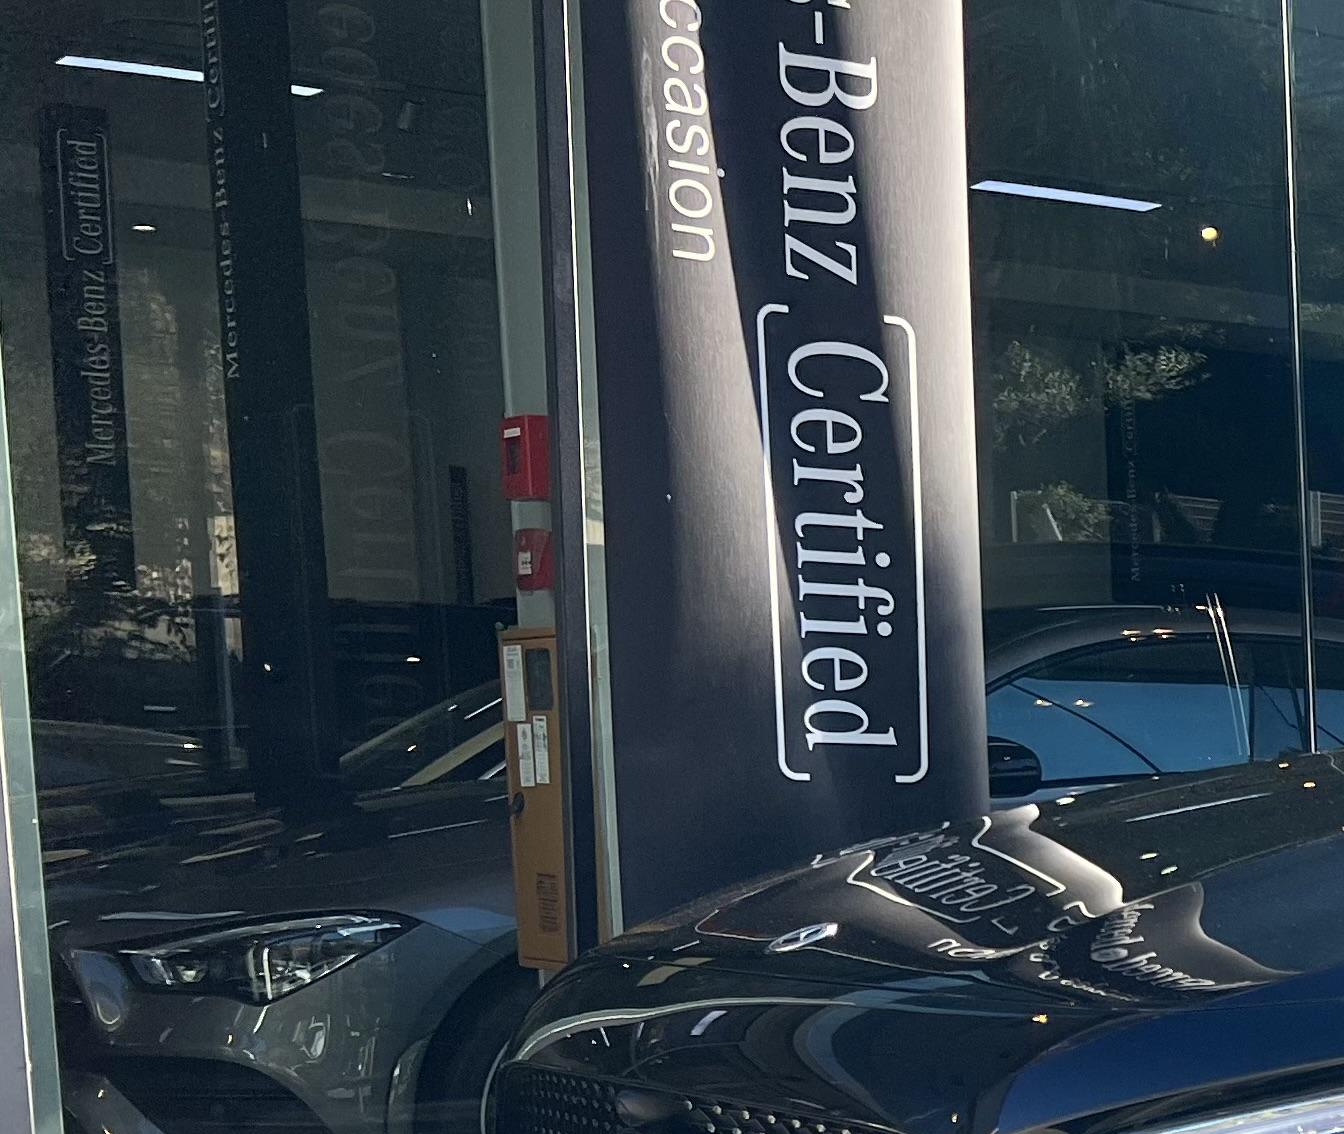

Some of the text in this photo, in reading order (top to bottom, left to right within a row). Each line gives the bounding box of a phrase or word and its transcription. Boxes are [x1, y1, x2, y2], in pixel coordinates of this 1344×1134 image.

[65, 139, 119, 467] Mercedes-Benz Certified
[786, 340, 897, 750] Certified
